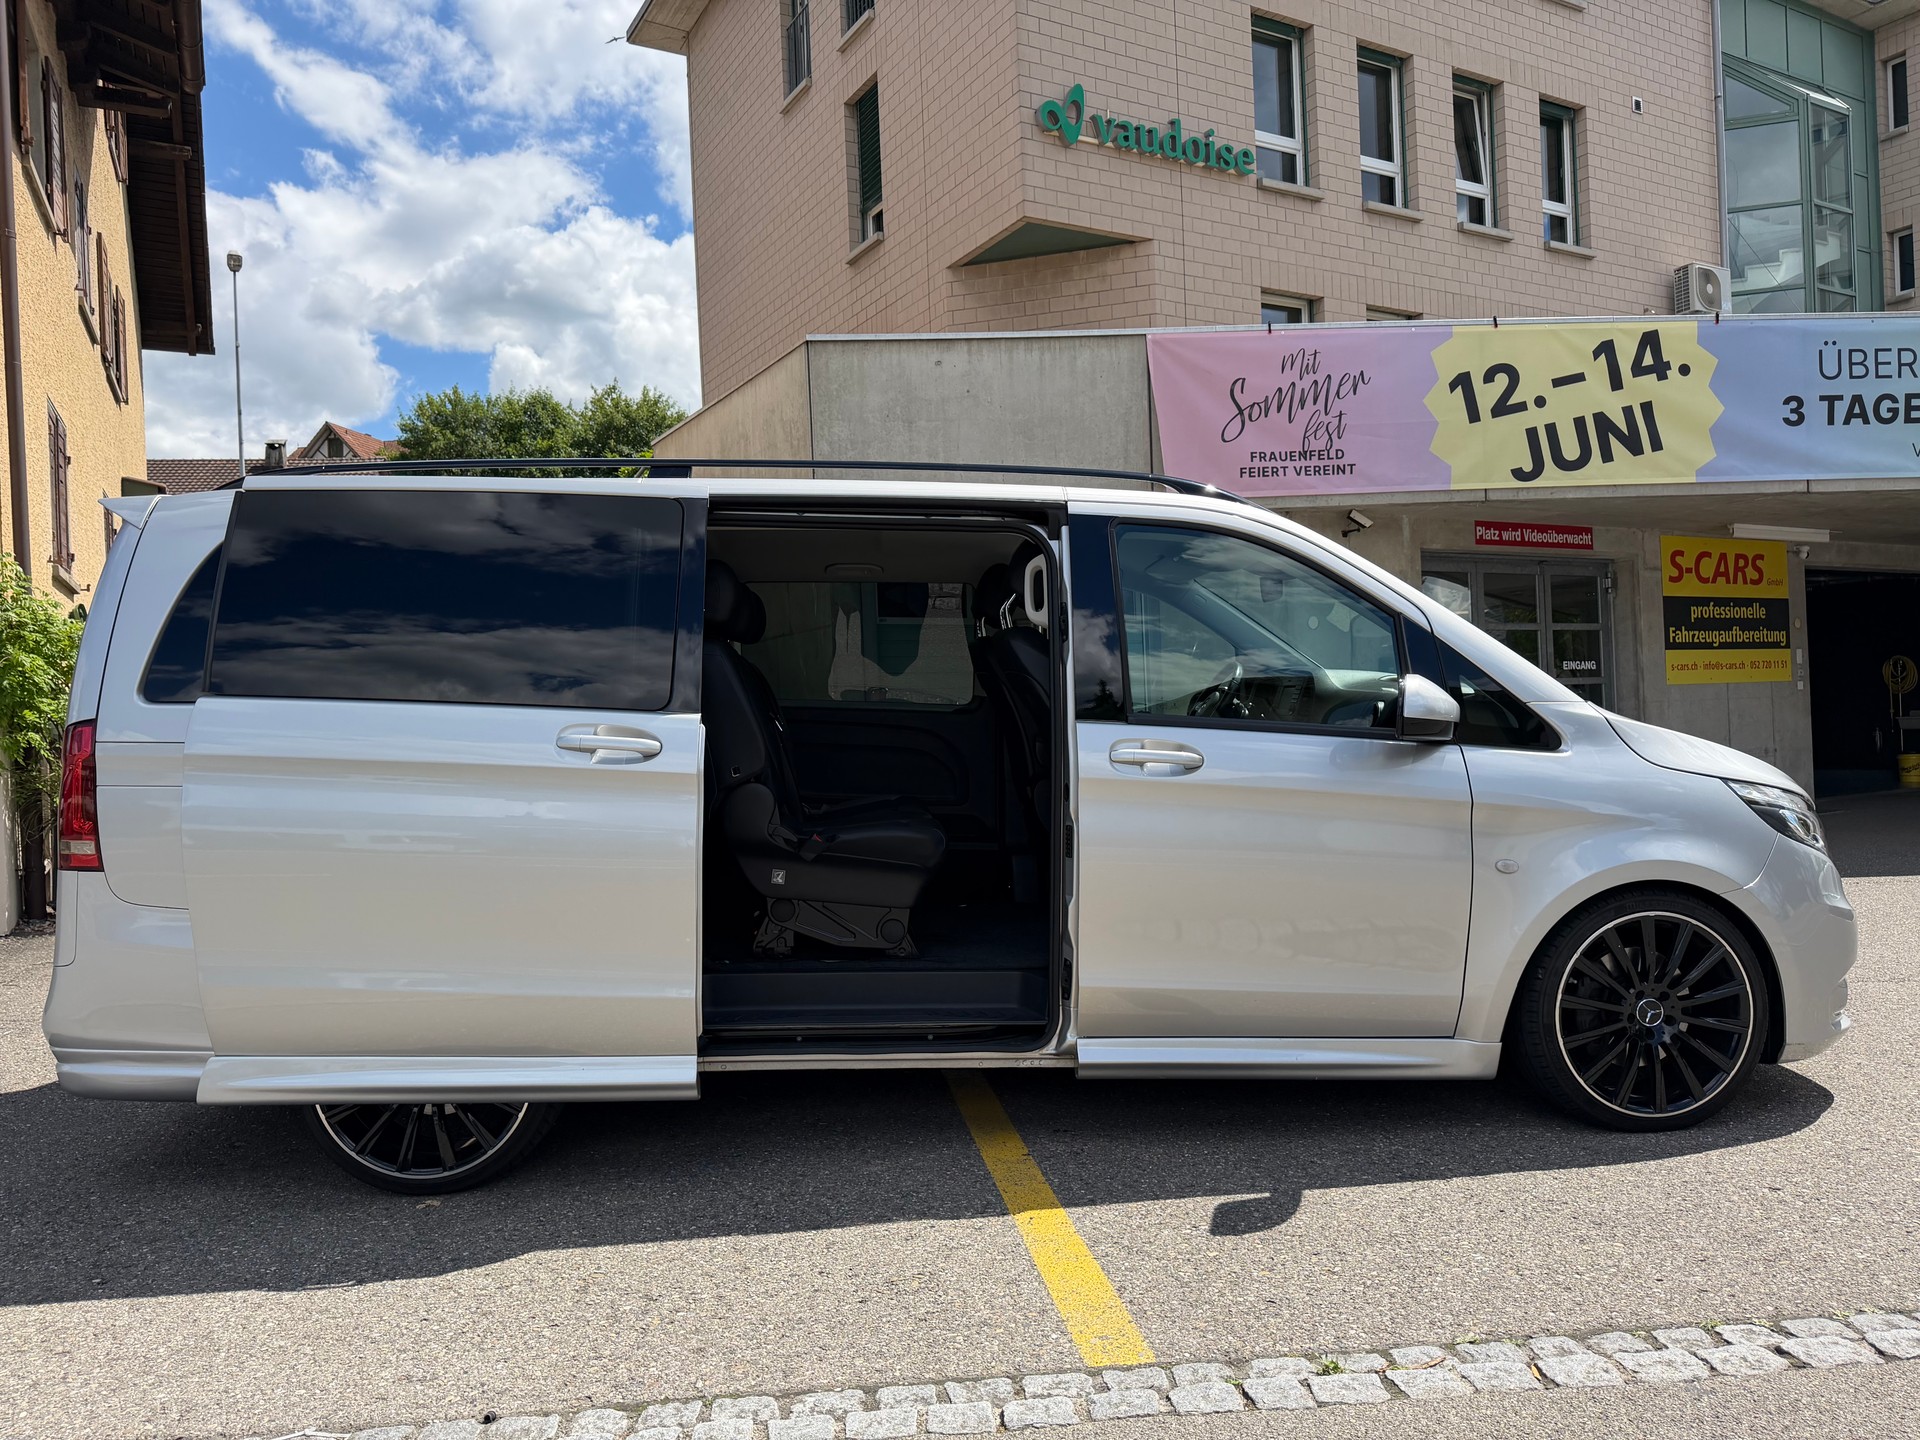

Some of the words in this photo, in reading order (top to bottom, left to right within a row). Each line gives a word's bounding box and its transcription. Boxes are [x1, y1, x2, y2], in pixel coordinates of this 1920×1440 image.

[1090, 113, 1256, 177] vaudoise
[1281, 348, 1321, 381] Mit
[1818, 340, 1919, 380] ÜBER
[1221, 370, 1371, 443] Sommer
[1782, 395, 1806, 427] 3
[1818, 392, 1920, 426] TAGE
[1302, 409, 1347, 454] fest
[1510, 401, 1664, 482] JUNI
[1239, 466, 1289, 478] FEIERT
[1293, 464, 1356, 476] VEREINT
[1250, 449, 1345, 462] FRAUENFELD
[1476, 526, 1500, 541] Platz
[1501, 529, 1521, 542] wird
[1523, 529, 1592, 545] Videoüberwacht
[1668, 549, 1765, 586] S-CARS
[1766, 577, 1784, 587] GmbH
[1690, 602, 1766, 622] professionelle
[1669, 626, 1787, 647] Fahrzeugaufbereitung
[1563, 661, 1597, 671] EINGANG
[1671, 661, 1698, 672] s-cars.ch
[1702, 660, 1746, 671] info@s-cars.ch
